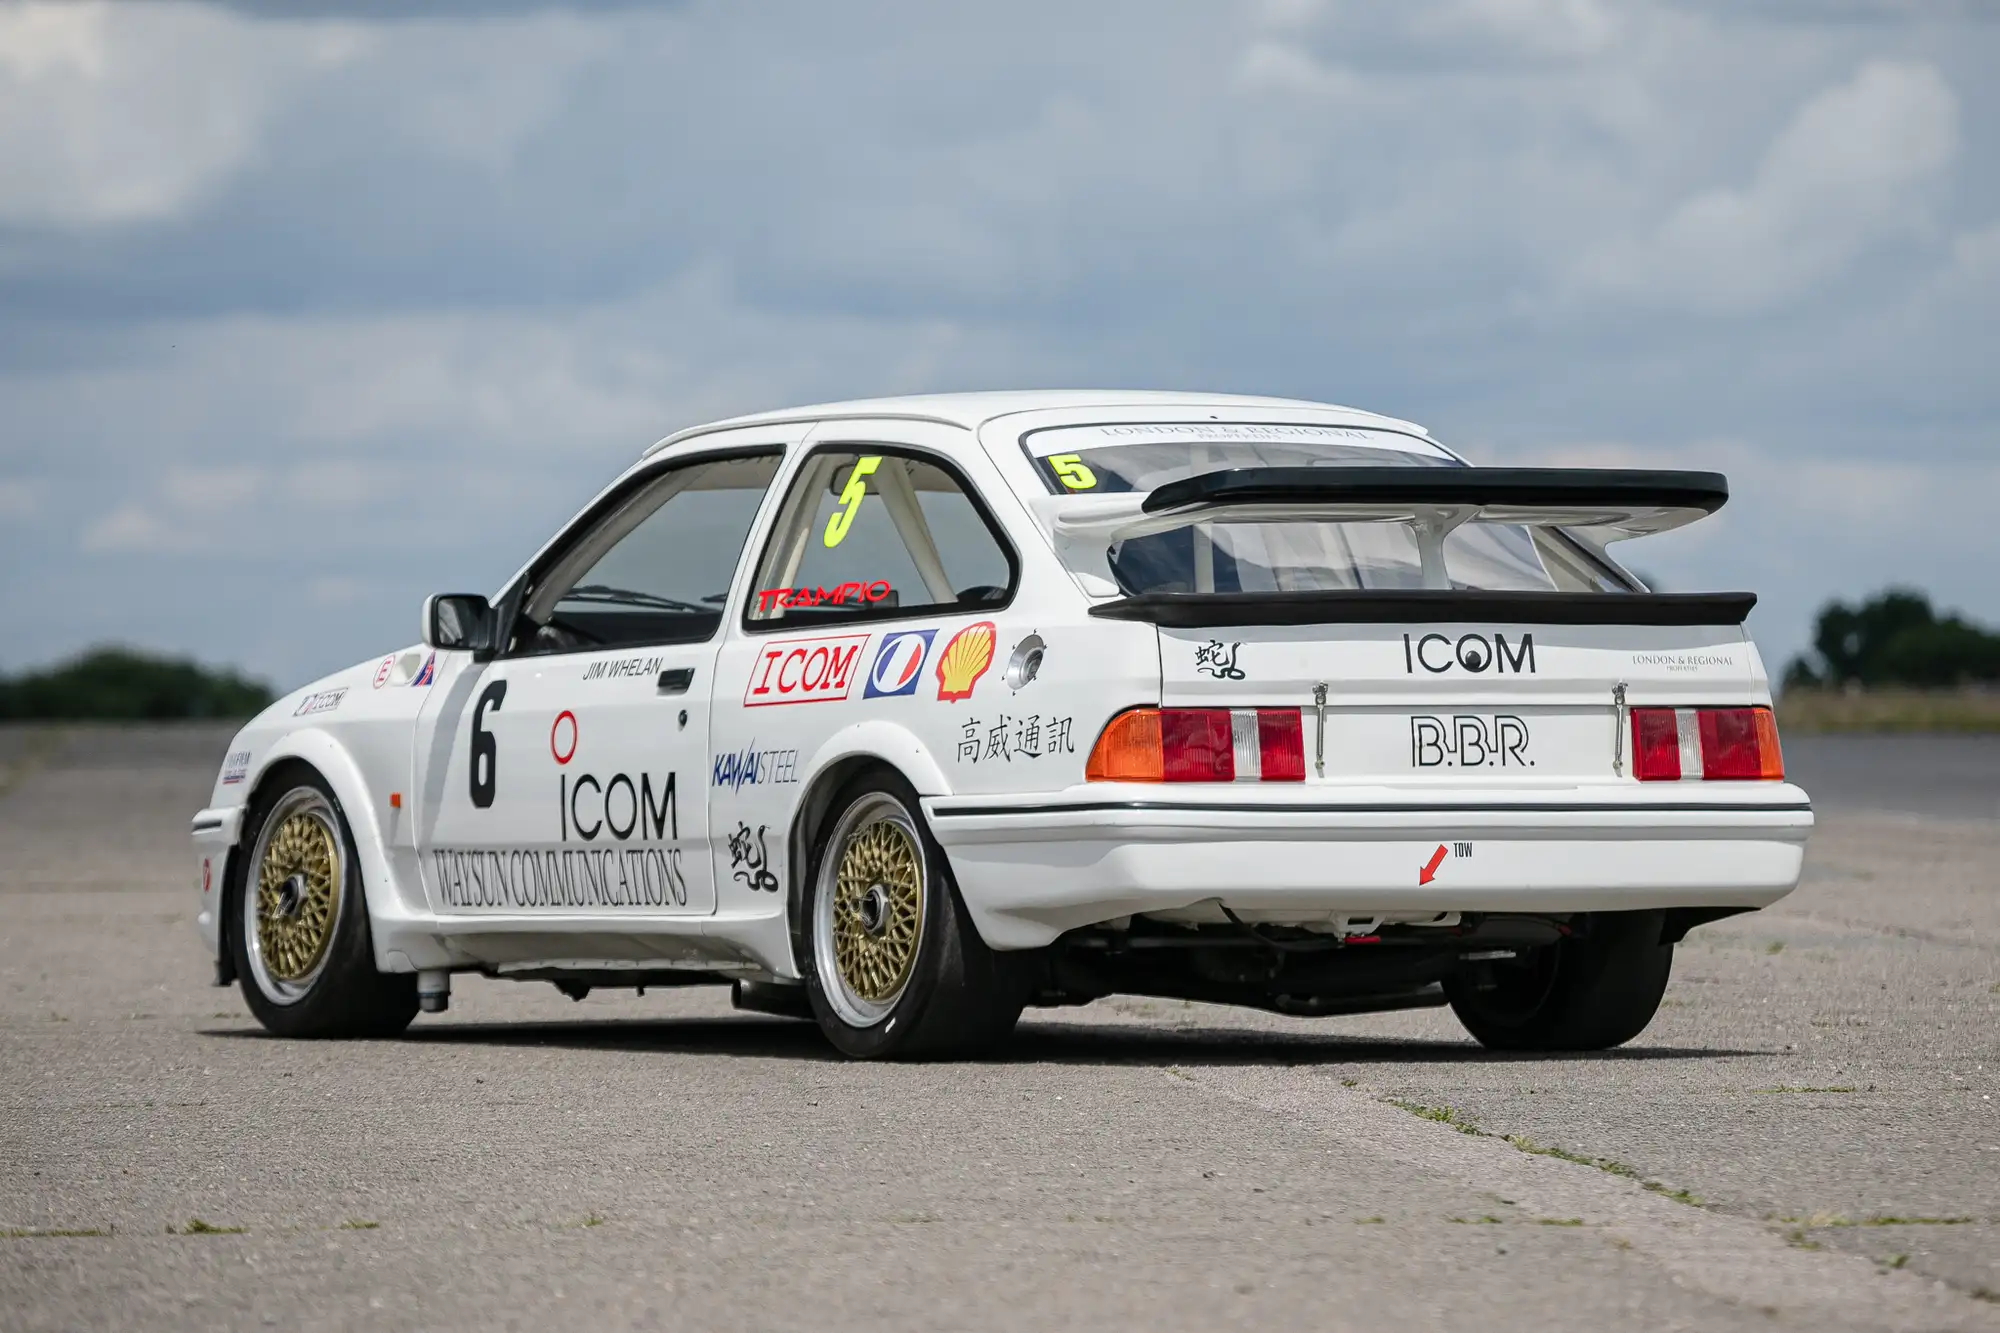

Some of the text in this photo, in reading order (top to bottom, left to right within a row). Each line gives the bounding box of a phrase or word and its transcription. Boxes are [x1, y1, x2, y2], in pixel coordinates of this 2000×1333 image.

[1048, 453, 1098, 490] 5
[823, 456, 883, 549] 5
[583, 657, 663, 681] JIM WHELAN
[753, 646, 859, 696] ICOM
[1404, 633, 1536, 674] ICOM
[1632, 655, 1732, 665] LONDON & REGIONAL
[470, 680, 507, 809] 6
[957, 714, 1075, 763] 高威通訊
[1410, 715, 1535, 766] B.B.R.
[561, 772, 677, 841] ICOM
[1454, 842, 1473, 858] TOW
[434, 848, 687, 906] WAYSUN COMMUNICATIONS
